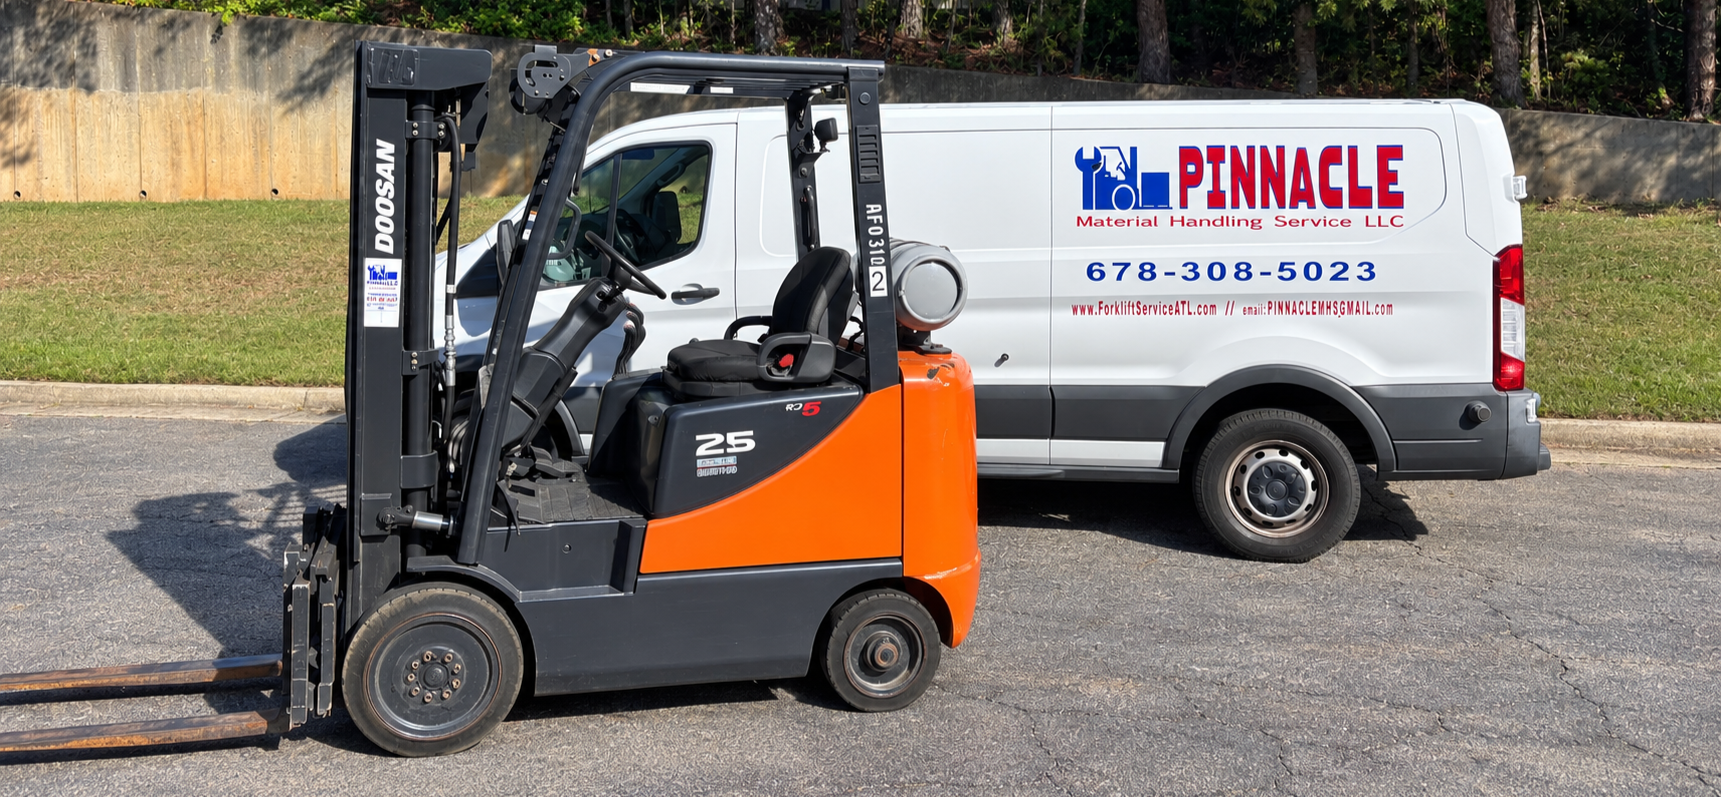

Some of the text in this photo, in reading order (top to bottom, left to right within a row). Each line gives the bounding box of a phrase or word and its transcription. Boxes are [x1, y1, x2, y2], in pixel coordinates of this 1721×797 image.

[1178, 144, 1405, 210] PINNACLE
[374, 138, 396, 255] DOOSAN
[1076, 215, 1404, 231] Material Handling Service LLC
[871, 271, 885, 292] 2
[1086, 261, 1376, 282] 678-308-5023
[1071, 300, 1217, 316] www.ForkliftServiceATL.com
[695, 430, 756, 457] 25
